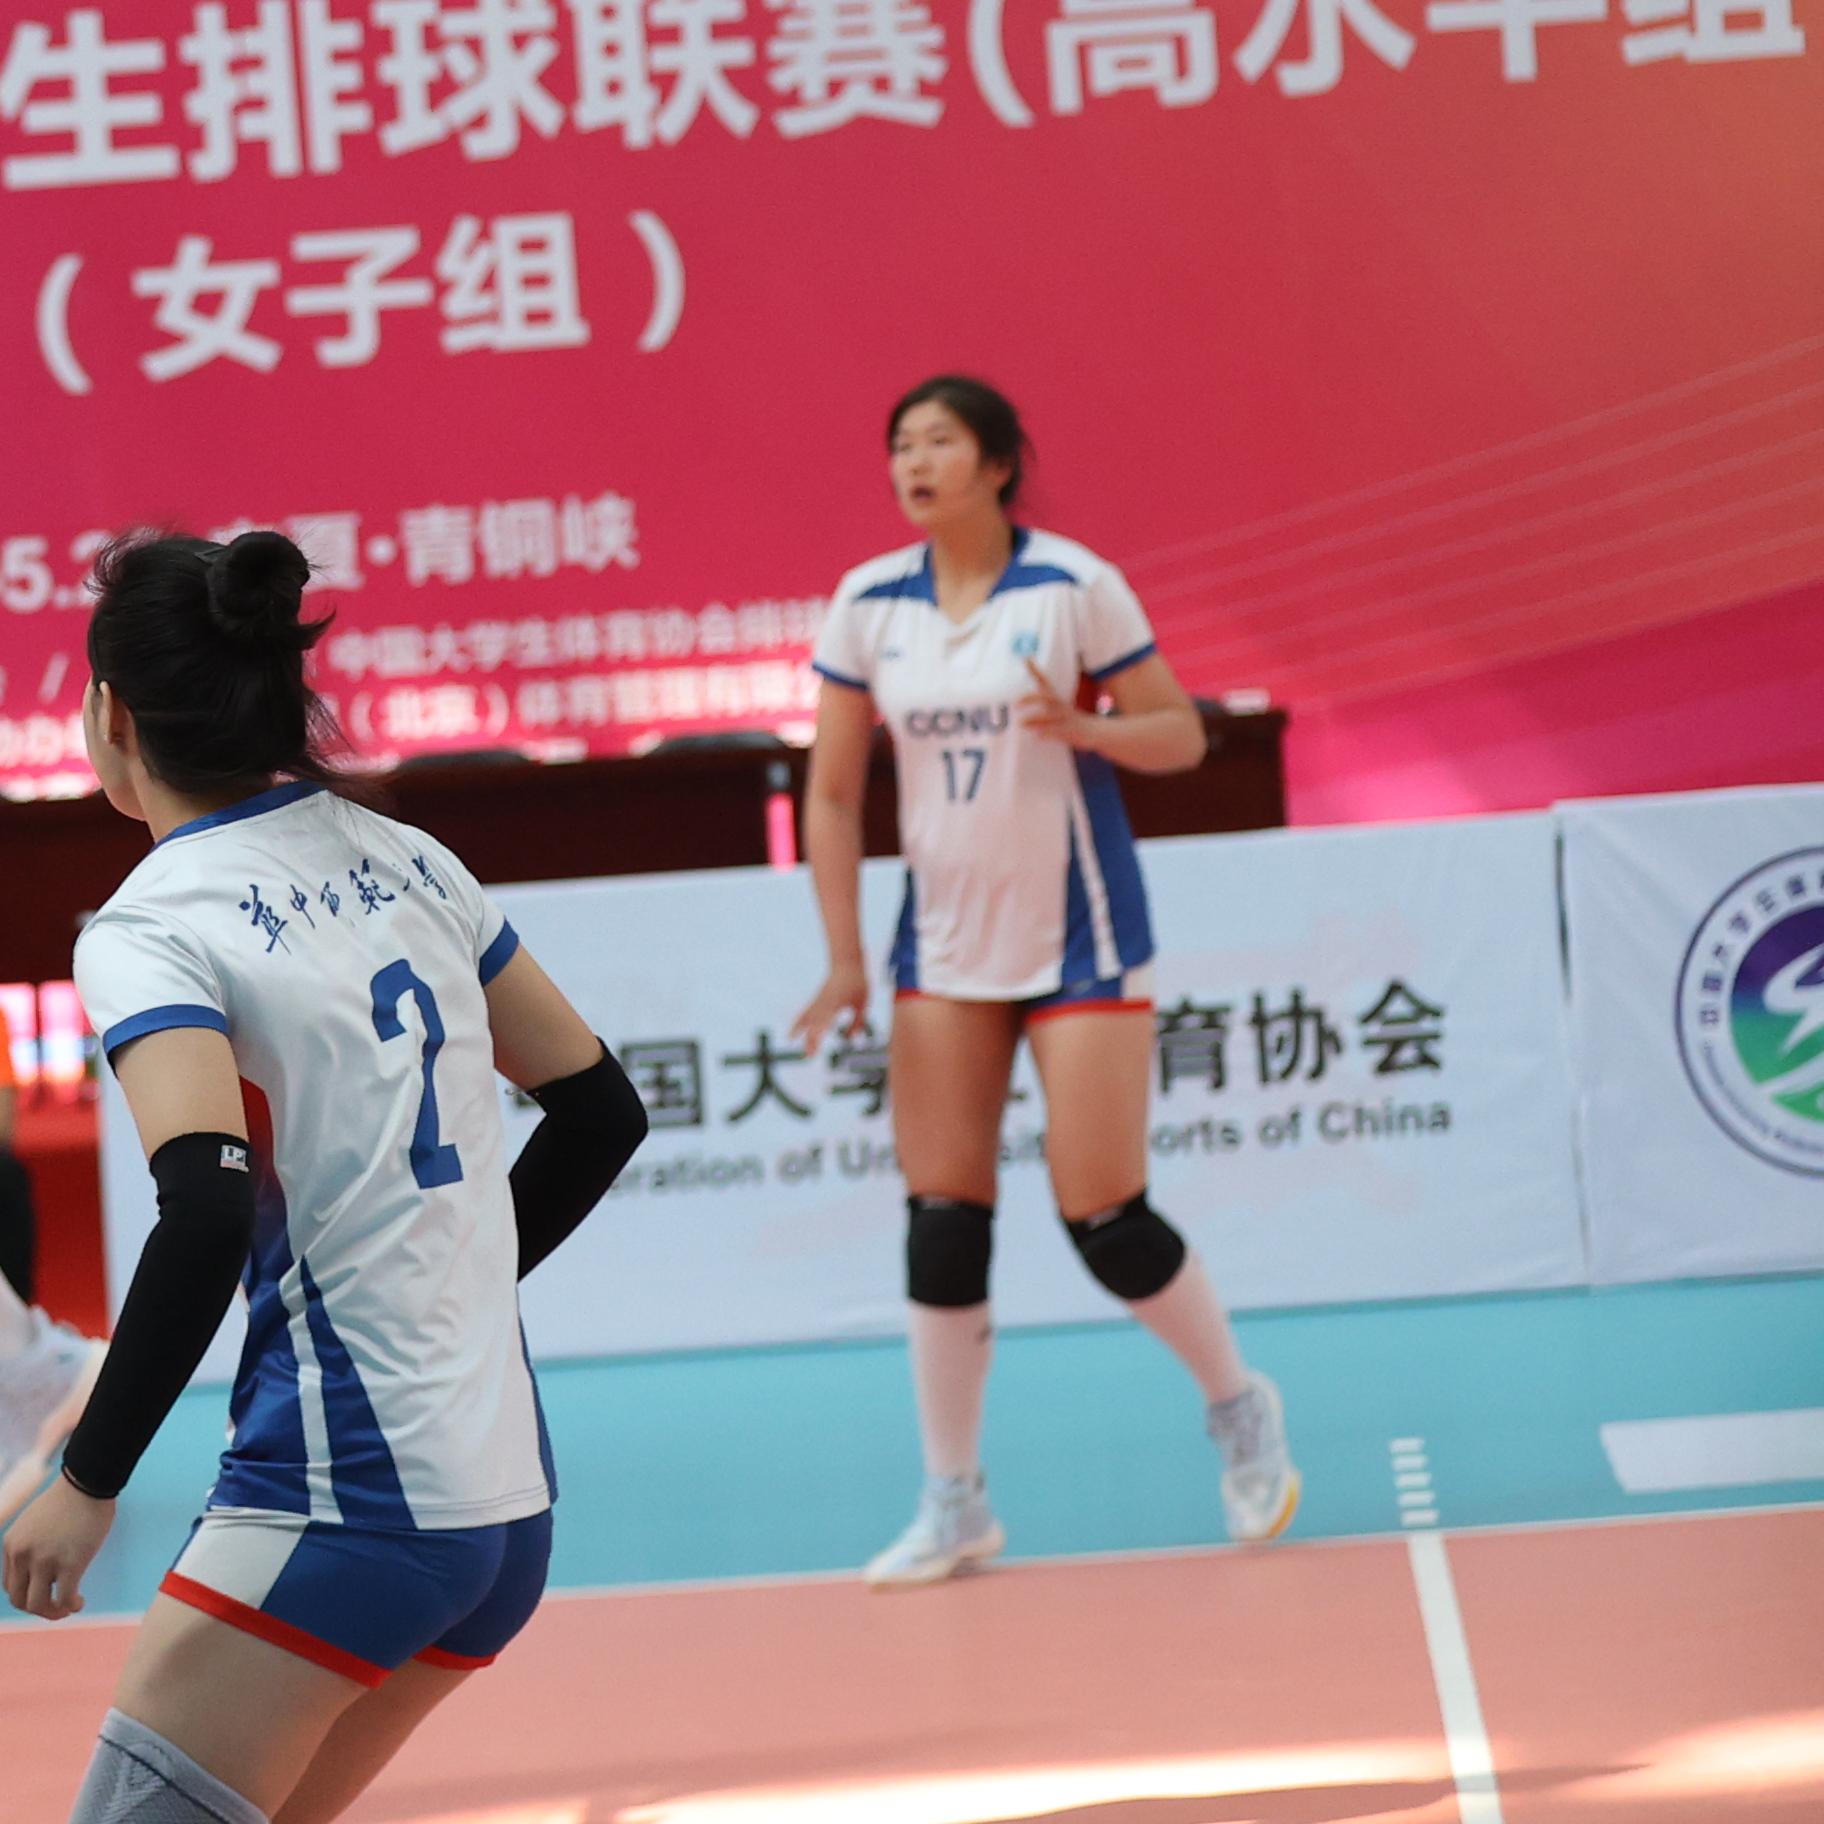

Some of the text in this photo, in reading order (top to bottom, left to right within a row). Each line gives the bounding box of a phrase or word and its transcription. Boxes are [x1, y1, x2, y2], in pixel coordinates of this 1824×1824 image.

[904, 705, 1010, 740] CCNU
[940, 747, 989, 804] 17
[369, 957, 464, 1190] 2
[1258, 1108, 1304, 1151] of
[1318, 1096, 1452, 1142] China
